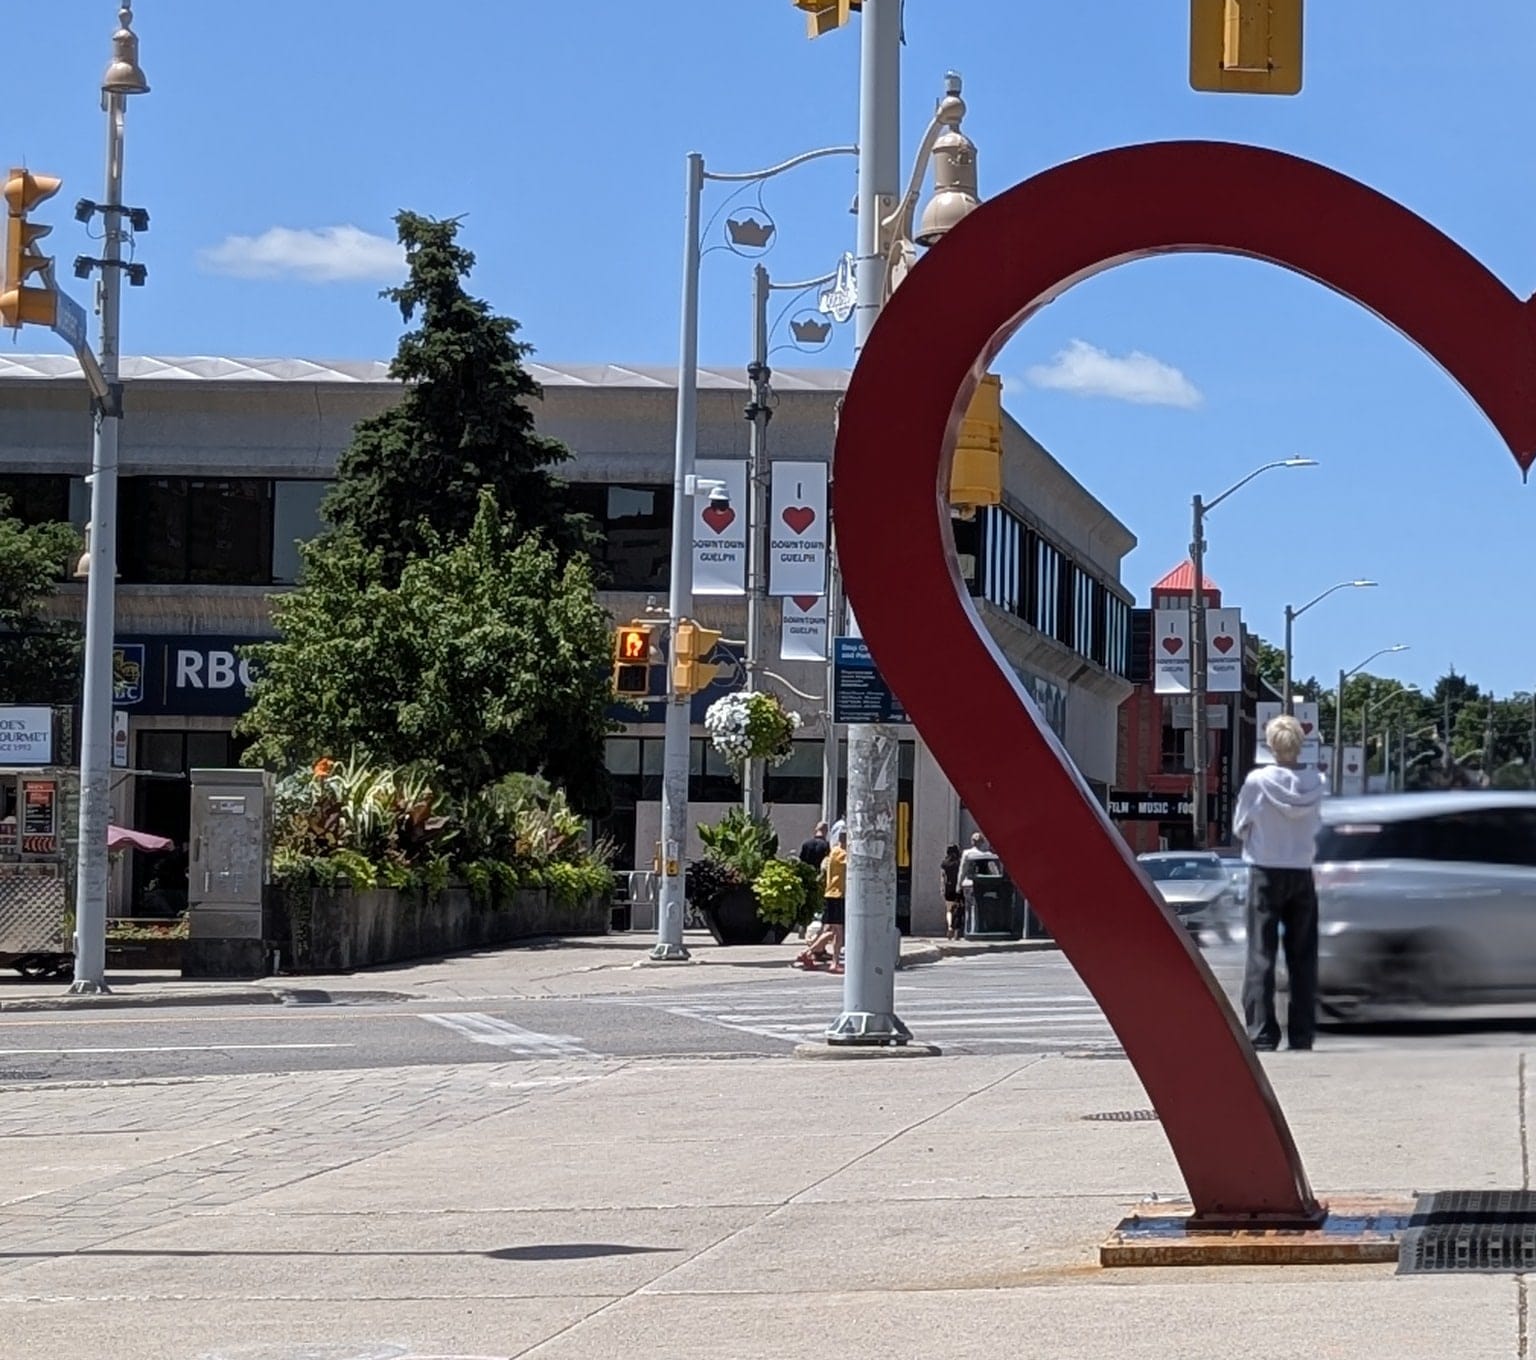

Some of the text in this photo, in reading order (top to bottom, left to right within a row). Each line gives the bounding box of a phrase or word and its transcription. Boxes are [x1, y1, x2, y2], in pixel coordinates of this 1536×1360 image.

[797, 482, 802, 500] I
[771, 540, 825, 550] DOWNTOWN
[700, 553, 735, 562] GUELPH
[780, 554, 815, 563] GUELPH
[1138, 802, 1169, 814] MUSIC
